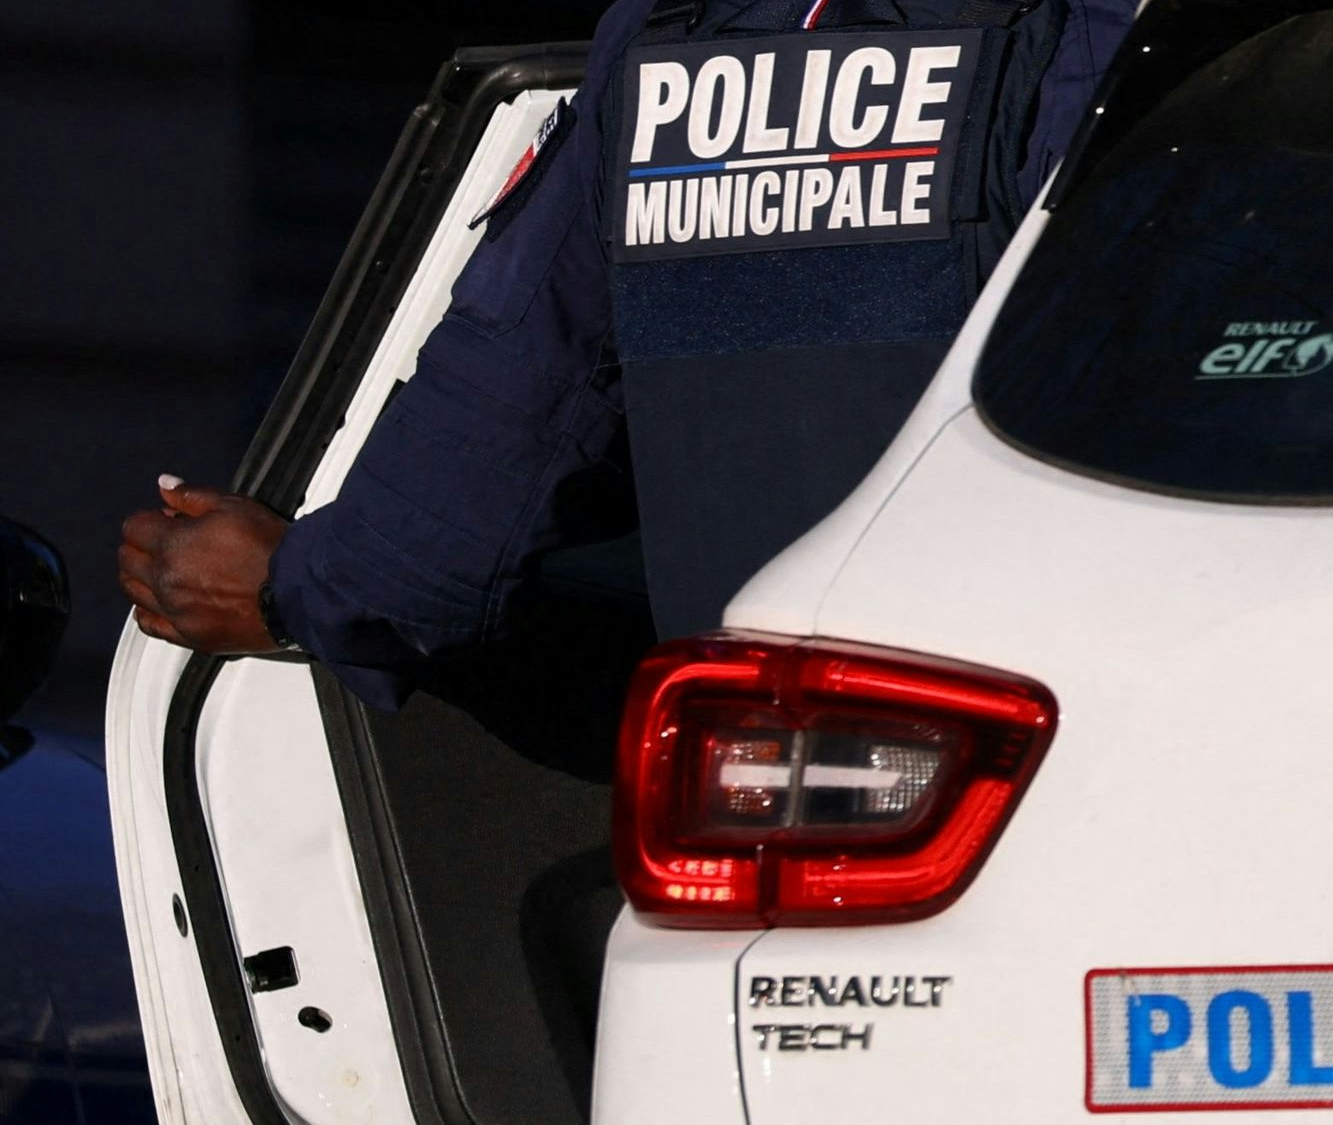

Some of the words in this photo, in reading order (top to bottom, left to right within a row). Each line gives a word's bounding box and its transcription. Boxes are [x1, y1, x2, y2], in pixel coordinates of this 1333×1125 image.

[630, 45, 962, 164] POLICE
[625, 161, 935, 247] MUNICIPALE
[1223, 320, 1319, 337] RENAULT
[1199, 338, 1297, 374] elf
[749, 976, 952, 1007] RENAULT
[752, 1025, 874, 1051] TECH
